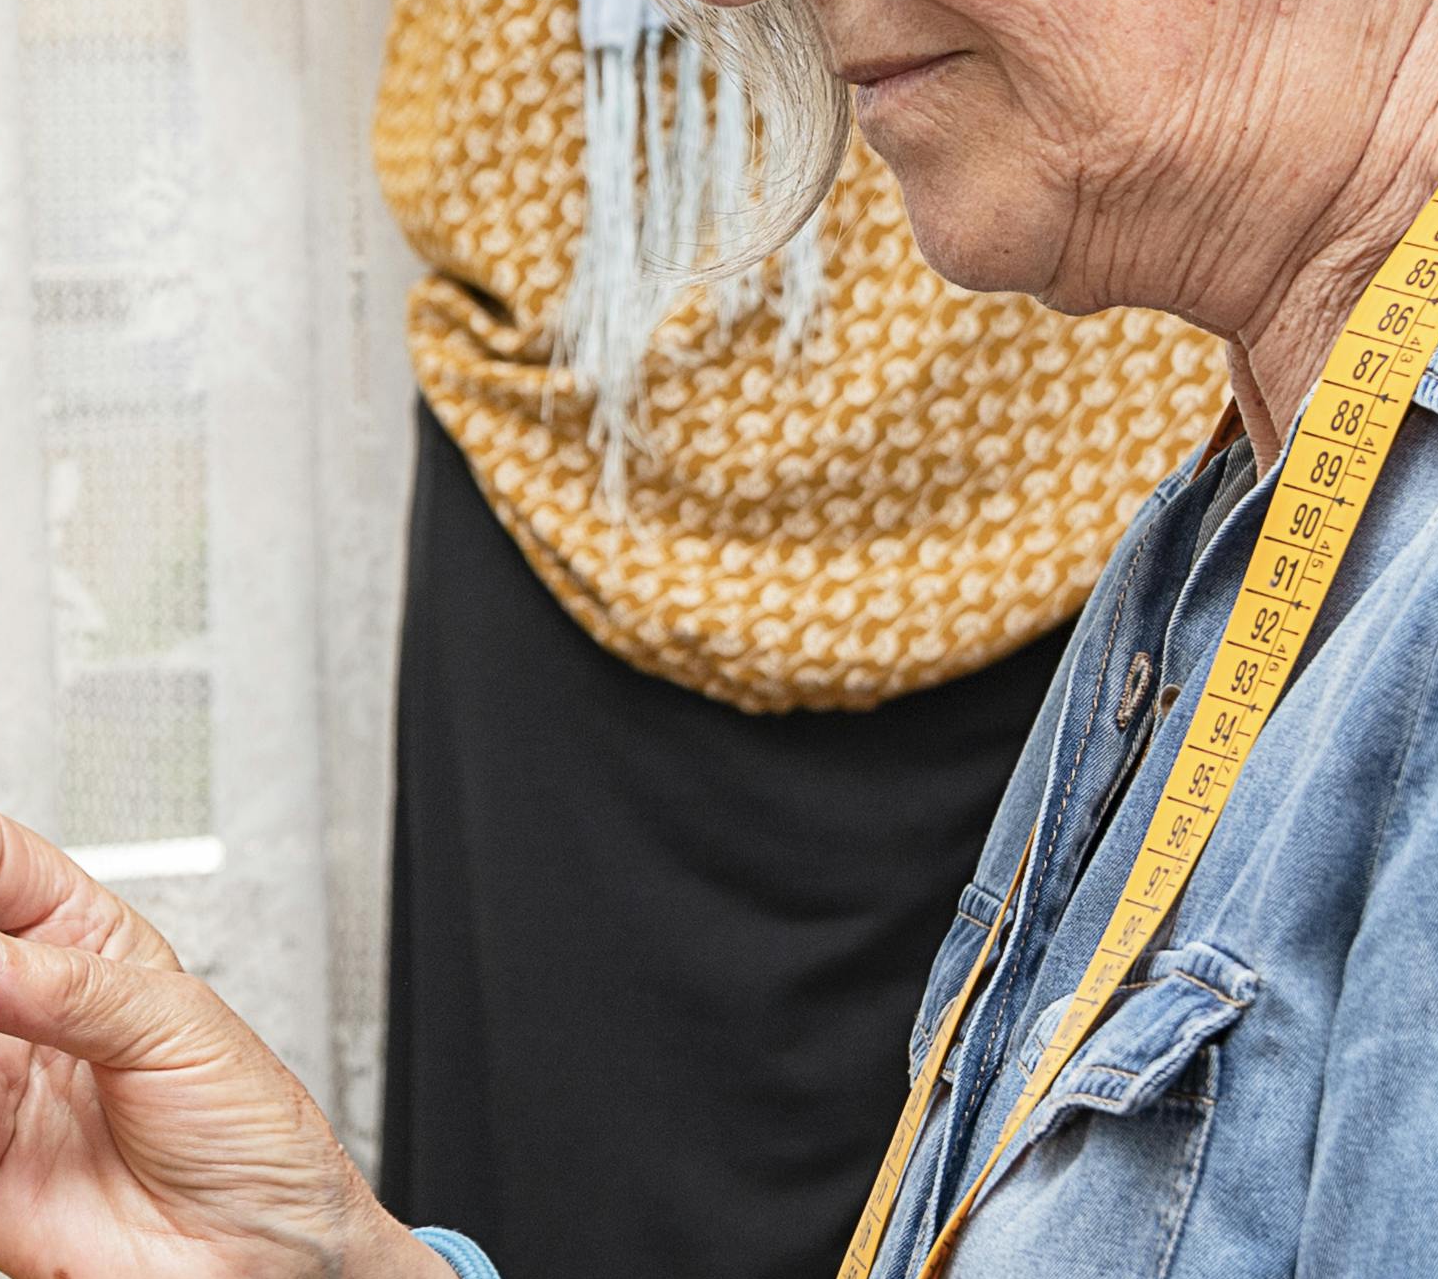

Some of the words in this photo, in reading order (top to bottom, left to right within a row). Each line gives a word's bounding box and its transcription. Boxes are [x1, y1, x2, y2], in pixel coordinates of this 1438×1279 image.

[1378, 303, 1414, 335] 86
[1352, 350, 1389, 383] 87
[1330, 400, 1364, 435] 88
[1310, 451, 1343, 487] 89
[1290, 503, 1321, 539] 90
[1270, 555, 1299, 591] 91
[1251, 608, 1280, 644] 92
[1231, 660, 1259, 695] 93
[1210, 712, 1238, 747] 94
[1188, 763, 1215, 798] 95
[1166, 815, 1192, 849] 96
[1144, 866, 1169, 898] 97
